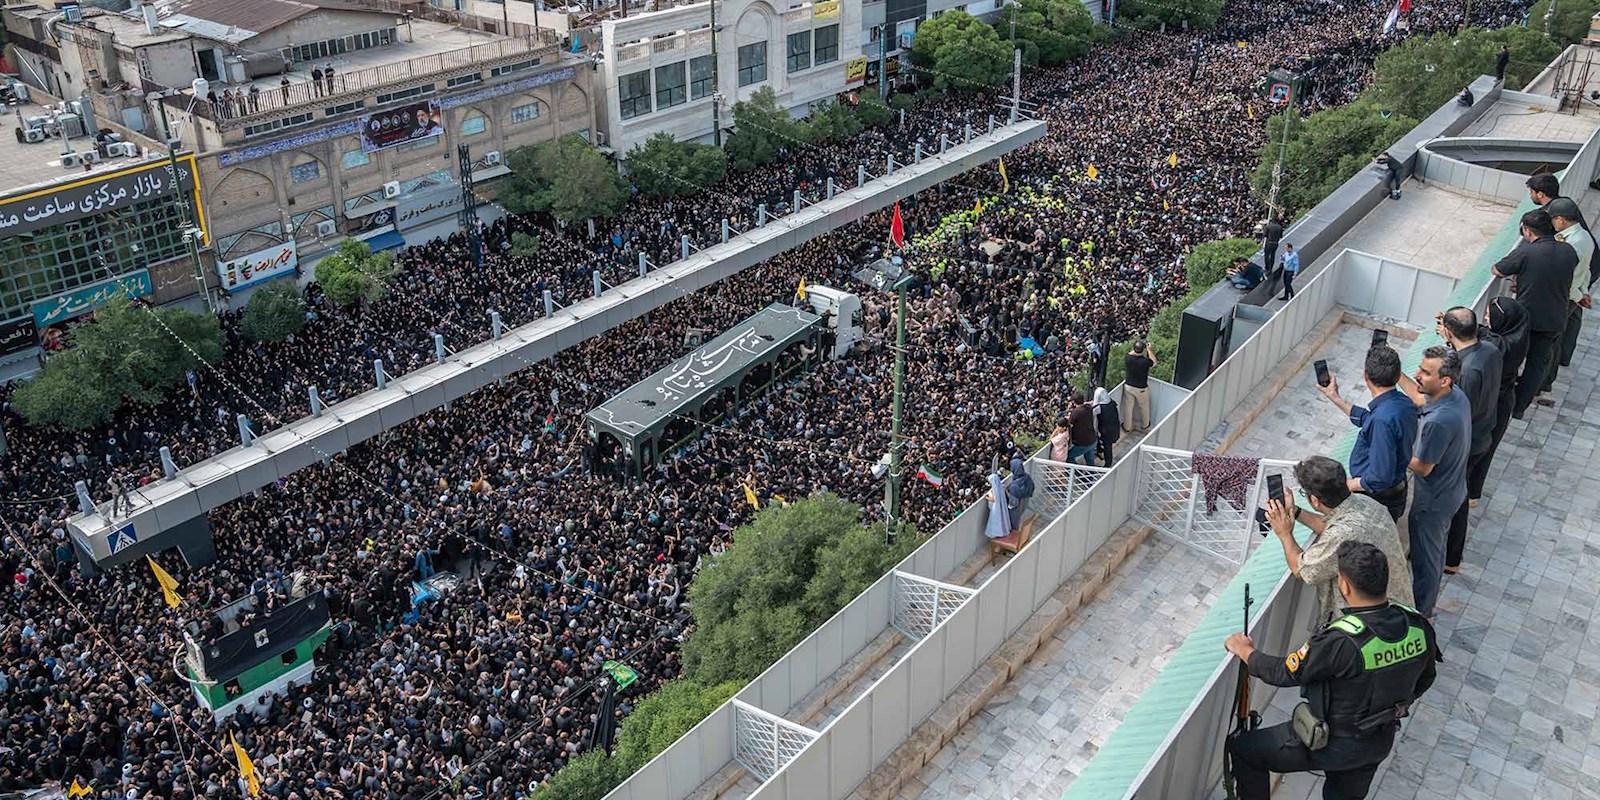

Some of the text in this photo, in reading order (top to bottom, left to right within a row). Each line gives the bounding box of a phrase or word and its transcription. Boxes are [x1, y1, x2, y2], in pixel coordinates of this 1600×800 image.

[79, 183, 126, 213] مرکزی
[131, 173, 162, 200] بازار
[23, 196, 75, 222] ساعت
[41, 296, 73, 322] مشهد
[739, 328, 765, 355] آمدم
[656, 386, 680, 401] بده
[1373, 638, 1422, 666] POLICE
